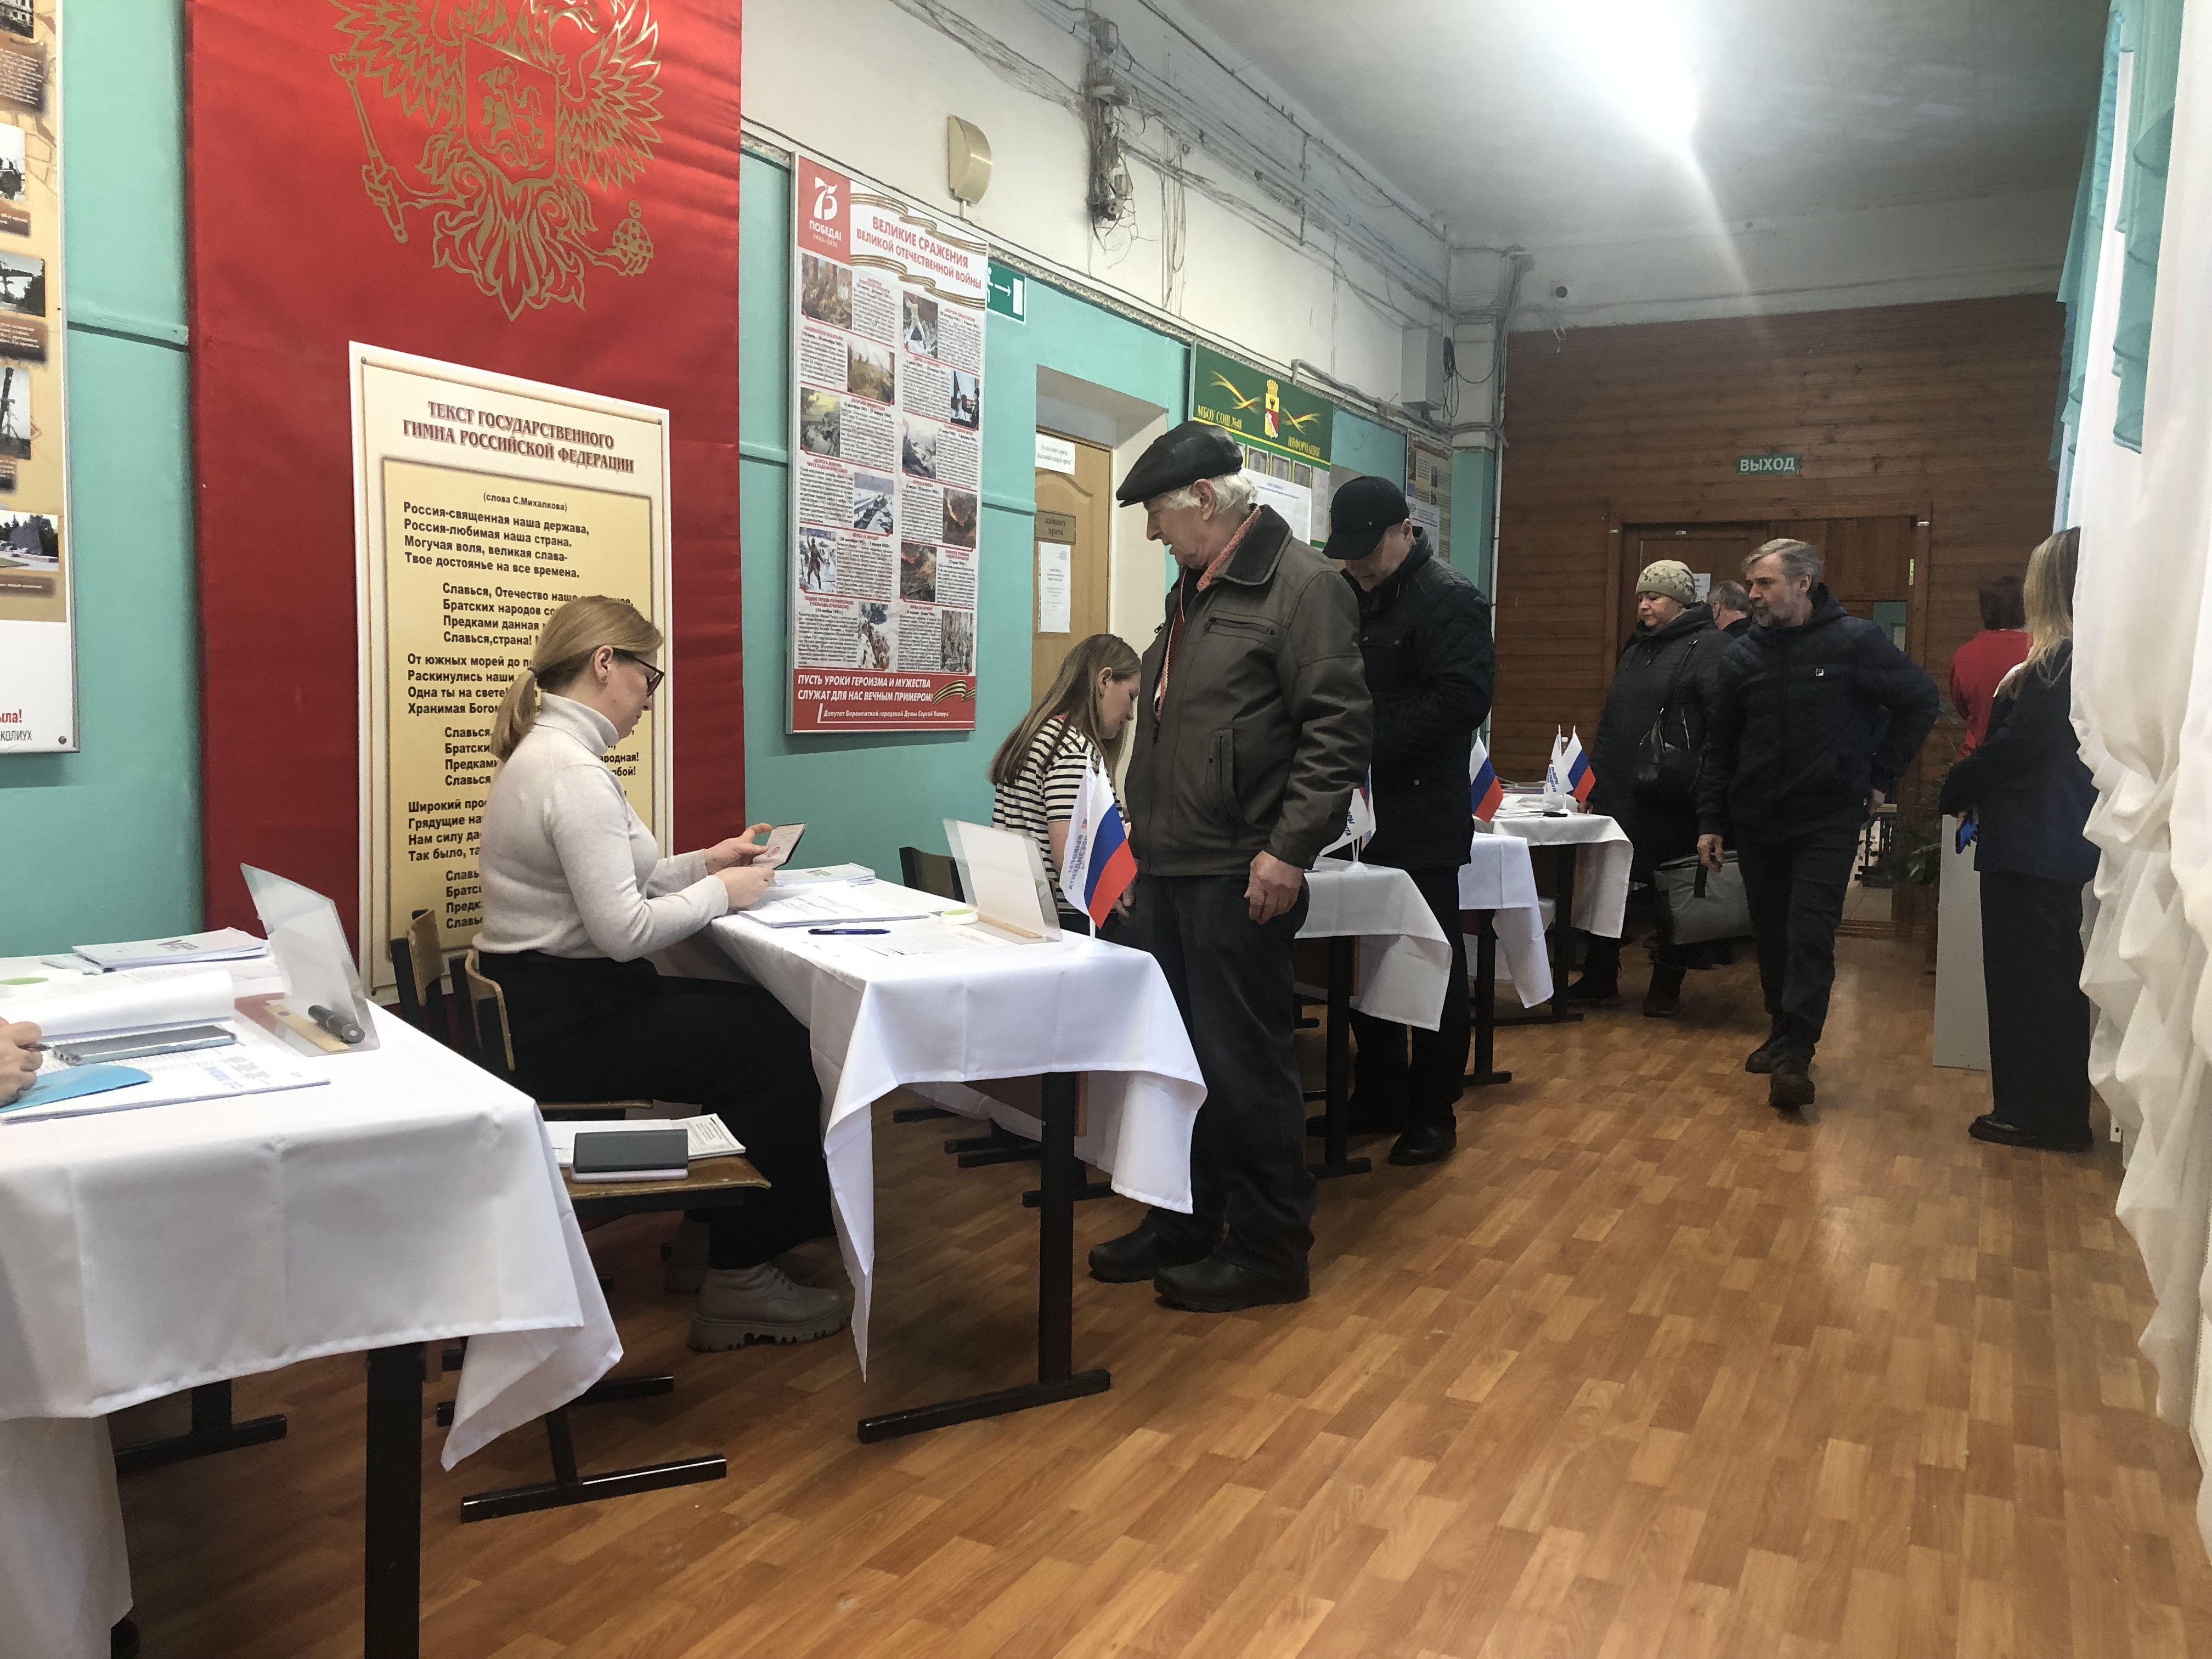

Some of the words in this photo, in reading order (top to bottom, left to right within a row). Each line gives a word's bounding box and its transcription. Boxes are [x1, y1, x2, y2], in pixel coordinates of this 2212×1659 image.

[814, 177, 838, 221] 75
[809, 219, 842, 241] ПОБЕДА!
[872, 216, 916, 246] ВЕЛИКИЕ
[918, 234, 968, 269] СРАЖЕНИЯ
[856, 228, 894, 253] ВЕЛИКОЙ
[895, 244, 954, 278] ОТЕЧЕСТВЕННОЙ
[955, 267, 981, 290] ВОЙНЫ
[428, 401, 473, 424] ТЕКСТ
[478, 410, 614, 449] ГОСУДАРСТВЕННОГО
[1198, 405, 1215, 422] МБОУ
[1216, 411, 1230, 426] СОШ
[1231, 418, 1242, 430] №48
[403, 420, 455, 443] ГИМНА
[460, 430, 555, 460] РОССИЙСКОЙ
[558, 447, 634, 473] ФЕДЕРАЦИИ
[1288, 436, 1321, 458] ИНФОРМАЦИЯ
[1740, 457, 1795, 471] ВЫХОД
[483, 492, 510, 504] (слова
[512, 496, 567, 512] С.Михалкова)
[404, 501, 510, 525] Россия-священная
[514, 518, 540, 528] наша
[544, 522, 589, 535] держава,
[404, 518, 500, 539] Россия-любимая
[504, 532, 531, 543] наша
[534, 535, 572, 548] страна.
[405, 535, 453, 550] Могучая
[456, 544, 485, 556] воля,
[488, 546, 532, 558] великая
[535, 551, 567, 562] слава-
[405, 552, 432, 565] Твое
[436, 556, 493, 571] достоянье
[496, 562, 509, 572] на
[513, 564, 530, 574] все
[534, 566, 579, 578] времена.
[443, 583, 492, 597] Славься,
[495, 587, 549, 601] Отечество
[443, 599, 494, 613] Братских
[498, 605, 541, 616] народов
[443, 615, 498, 629] Предками
[502, 621, 539, 631] данная
[444, 631, 532, 646] Славься,страна!
[408, 653, 421, 665] От
[425, 657, 467, 666] южных
[470, 656, 504, 669] морей
[507, 659, 520, 669] до
[408, 670, 482, 685] Раскинулись
[486, 674, 514, 682] наши
[798, 674, 822, 685] ПУСТЬ
[824, 675, 850, 686] УРОКИ
[851, 676, 888, 686] ГЕРОИЗМА
[889, 678, 895, 687] И
[896, 678, 930, 688] МУЖЕСТВА
[408, 687, 437, 699] Одна
[441, 689, 455, 698] ты
[459, 689, 472, 697] на
[798, 690, 831, 700] СЛУЖАТ
[831, 691, 847, 702] ДЛЯ
[849, 691, 863, 701] НАС
[864, 692, 893, 701] ВЕЧНЫМ
[894, 692, 933, 702] ПРИМЕРОМ!
[408, 703, 465, 716] Хранимая
[1, 730, 32, 741] КОЛИУХ
[444, 727, 492, 738] Славься
[445, 743, 490, 756] Братски
[600, 752, 639, 764] ародная!
[445, 775, 491, 786] Славься
[611, 766, 636, 776] обой!
[409, 799, 461, 813] Широкий
[408, 815, 465, 831] Грядущие
[469, 815, 483, 824] на
[409, 833, 432, 845] Нам
[436, 833, 463, 844] силу
[409, 849, 429, 861] Так
[433, 845, 466, 859] было,
[469, 847, 480, 856] та
[445, 870, 479, 882] Славь
[446, 885, 481, 899] Братс
[446, 901, 483, 915] Предк
